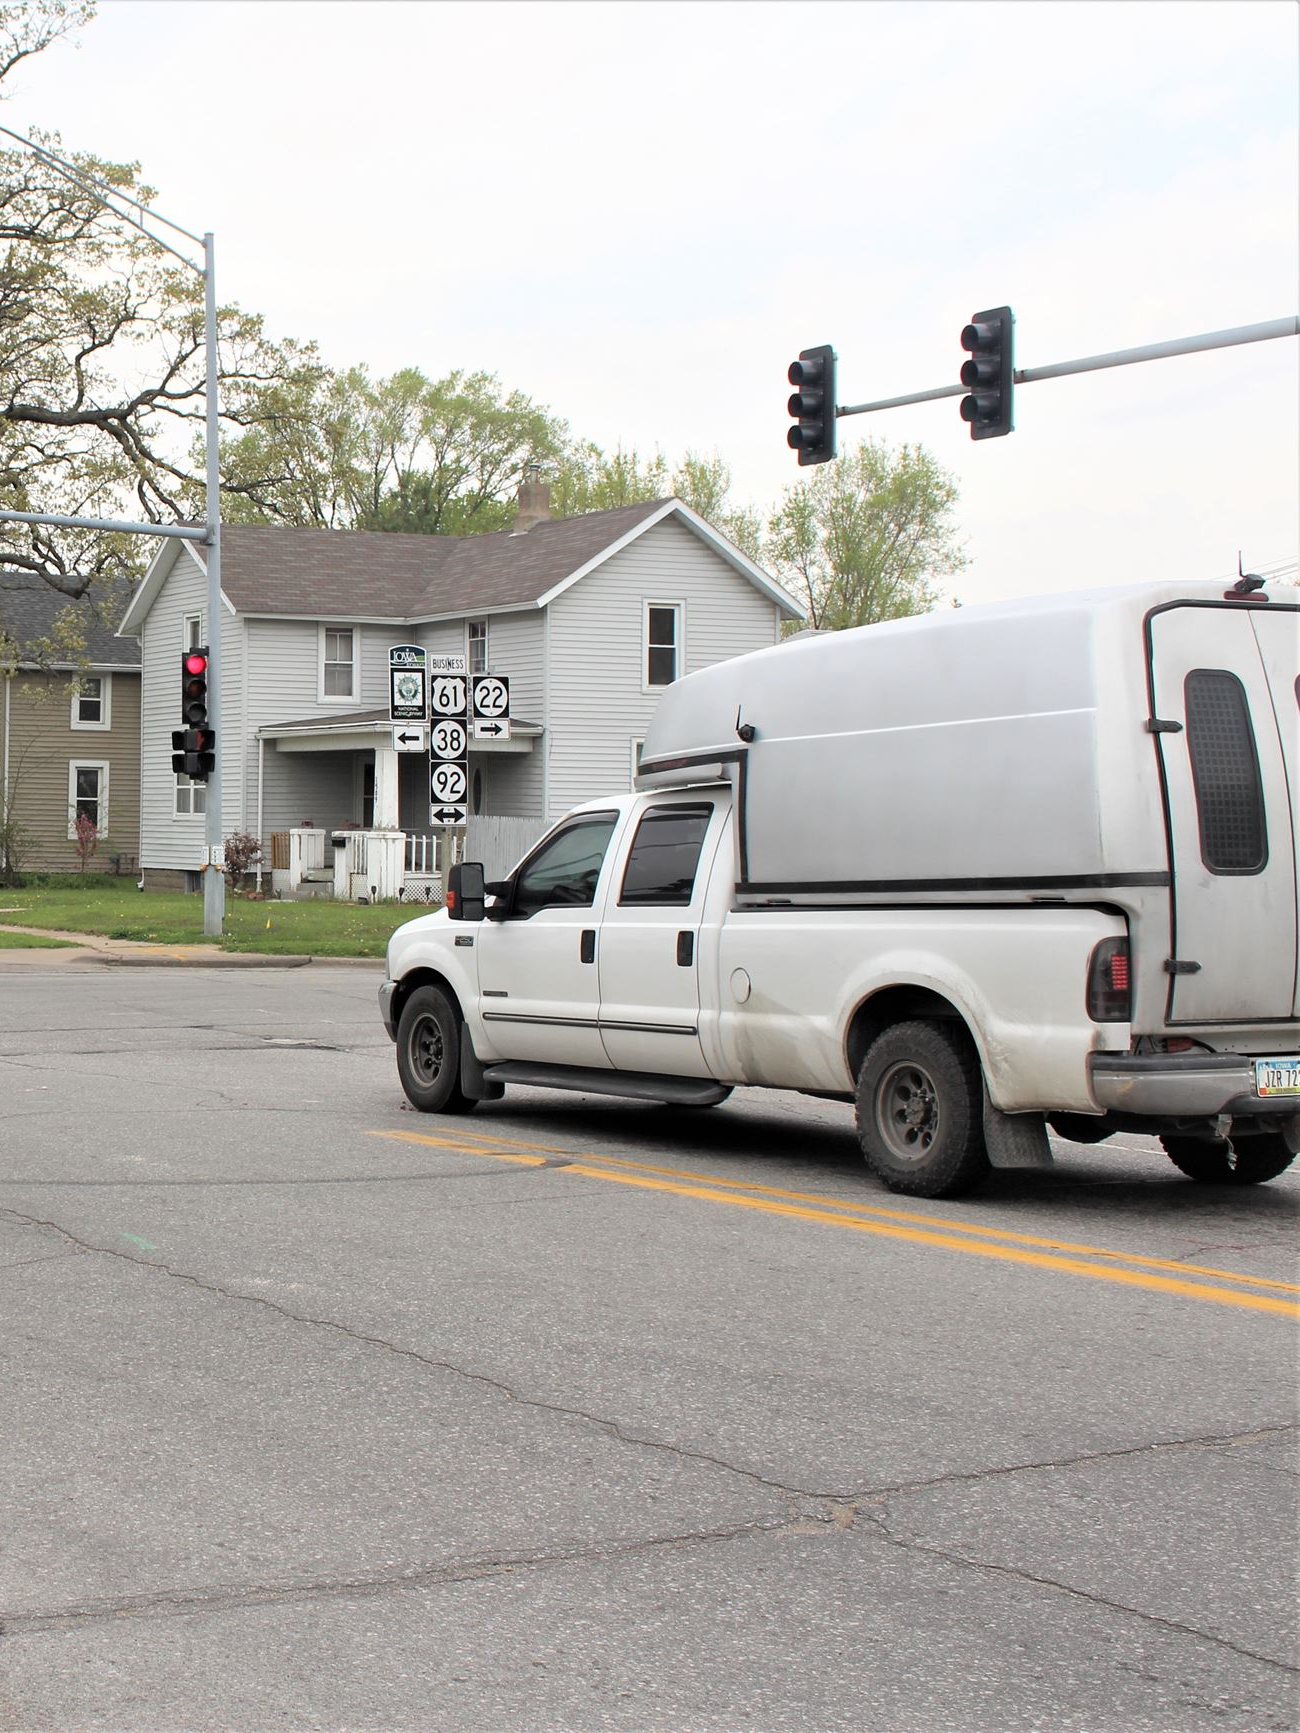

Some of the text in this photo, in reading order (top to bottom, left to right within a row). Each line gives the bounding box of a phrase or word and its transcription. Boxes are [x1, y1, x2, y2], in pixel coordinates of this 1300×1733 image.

[393, 650, 418, 662] IOWA
[432, 658, 464, 670] BUSINESS
[439, 685, 457, 707] 61
[479, 685, 503, 708] 22
[437, 728, 461, 752] 38
[437, 771, 461, 794] 92
[1265, 1070, 1283, 1088] JZR
